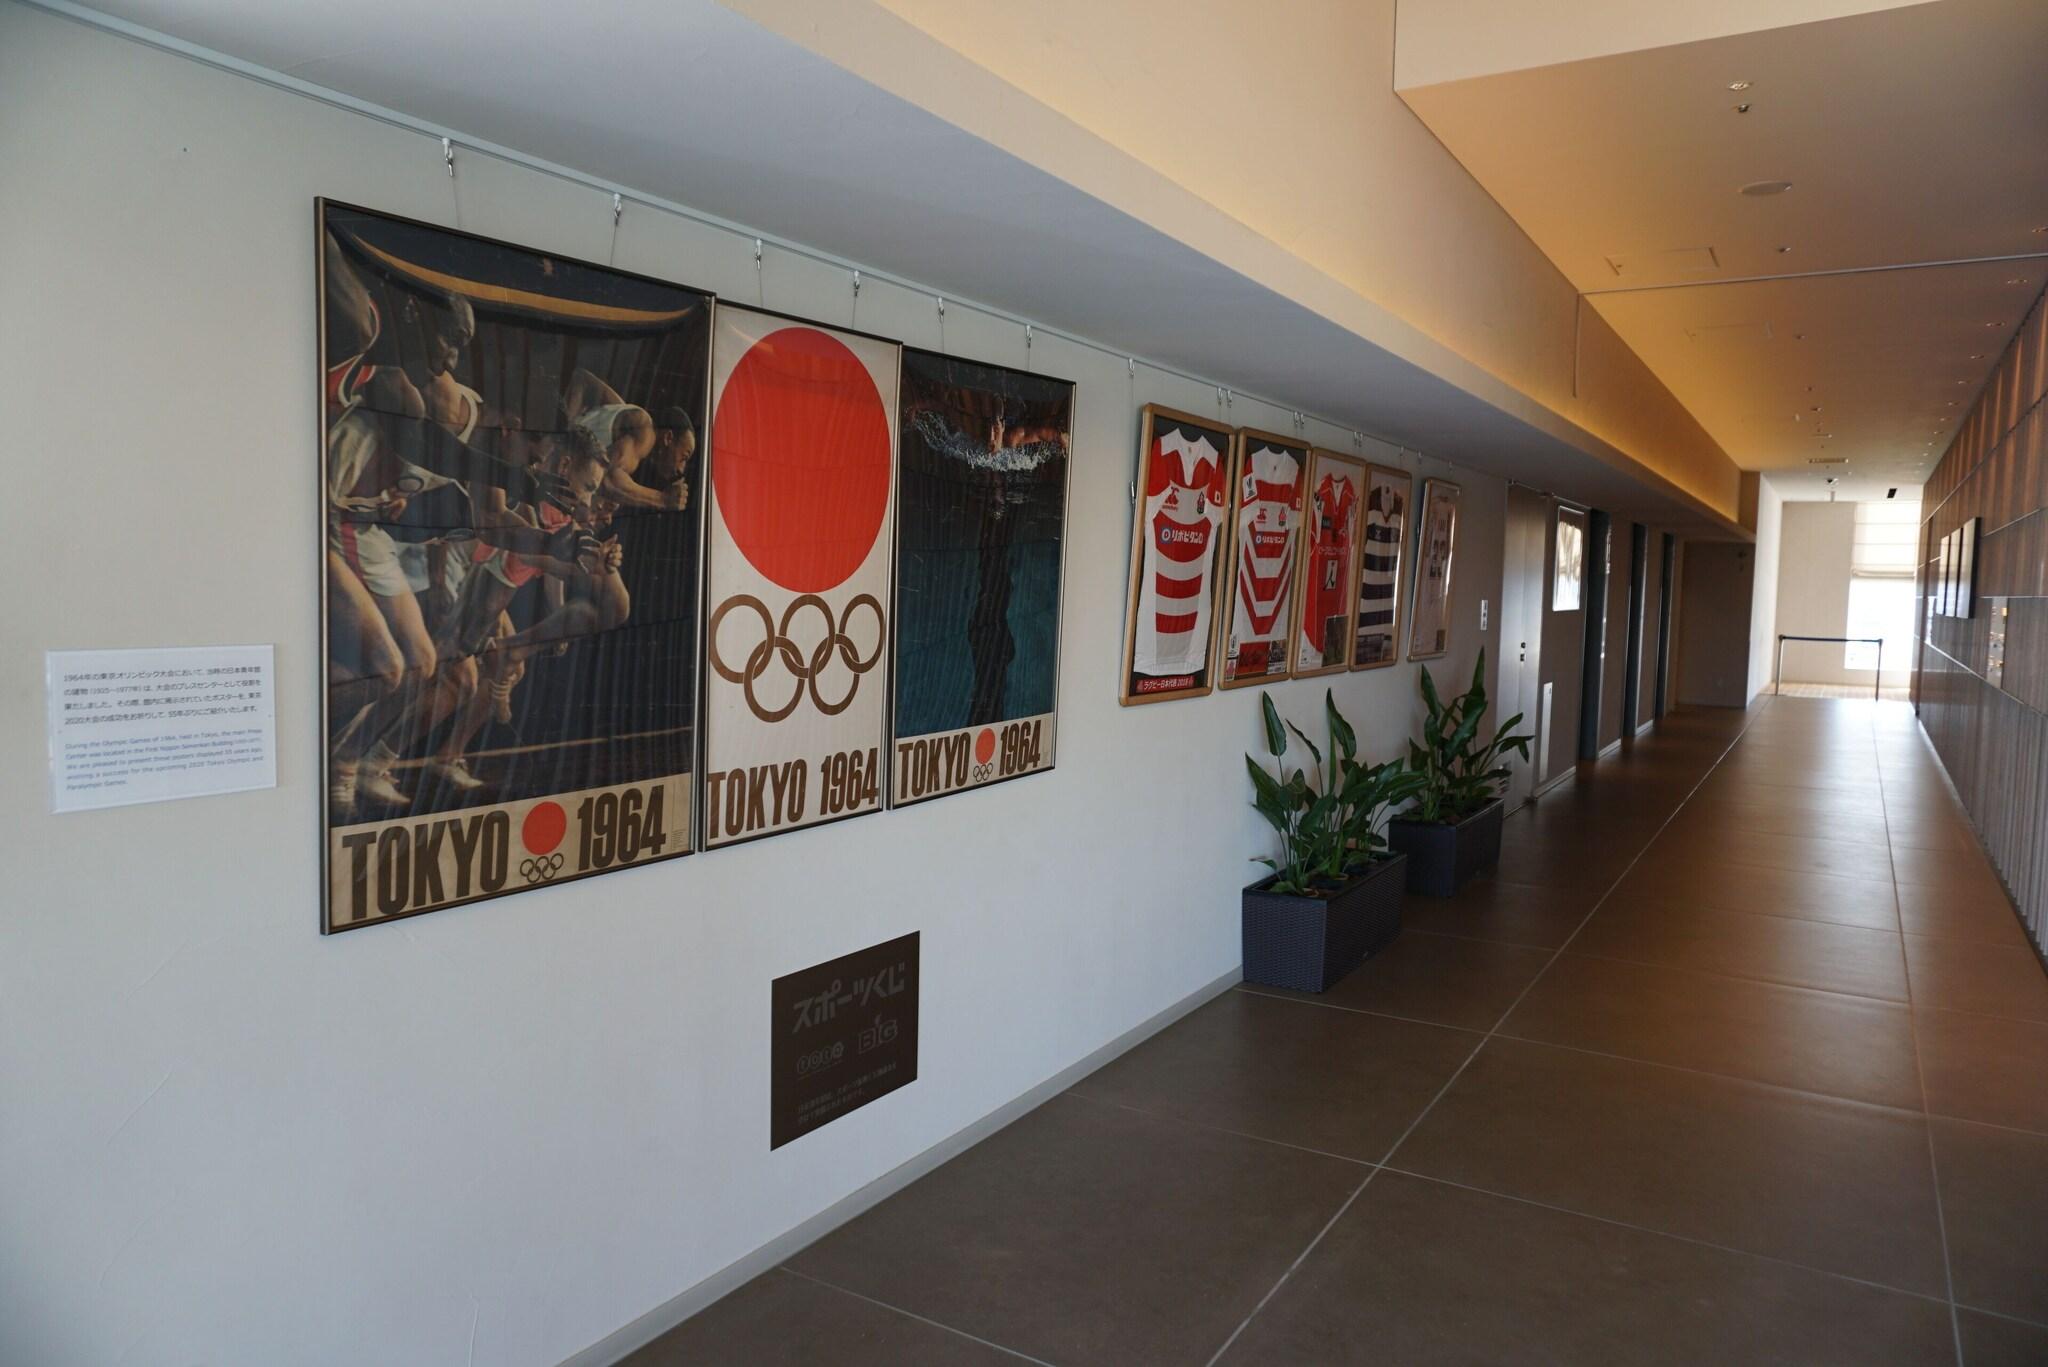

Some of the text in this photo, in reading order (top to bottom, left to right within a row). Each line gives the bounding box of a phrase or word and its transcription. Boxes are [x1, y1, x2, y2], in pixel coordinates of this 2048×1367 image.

[707, 748, 879, 839] TOKYO 1964
[897, 719, 1042, 800] TOKYO 1964
[342, 784, 666, 920] TOKYO 1964
[792, 962, 905, 1034] スポーツくじ
